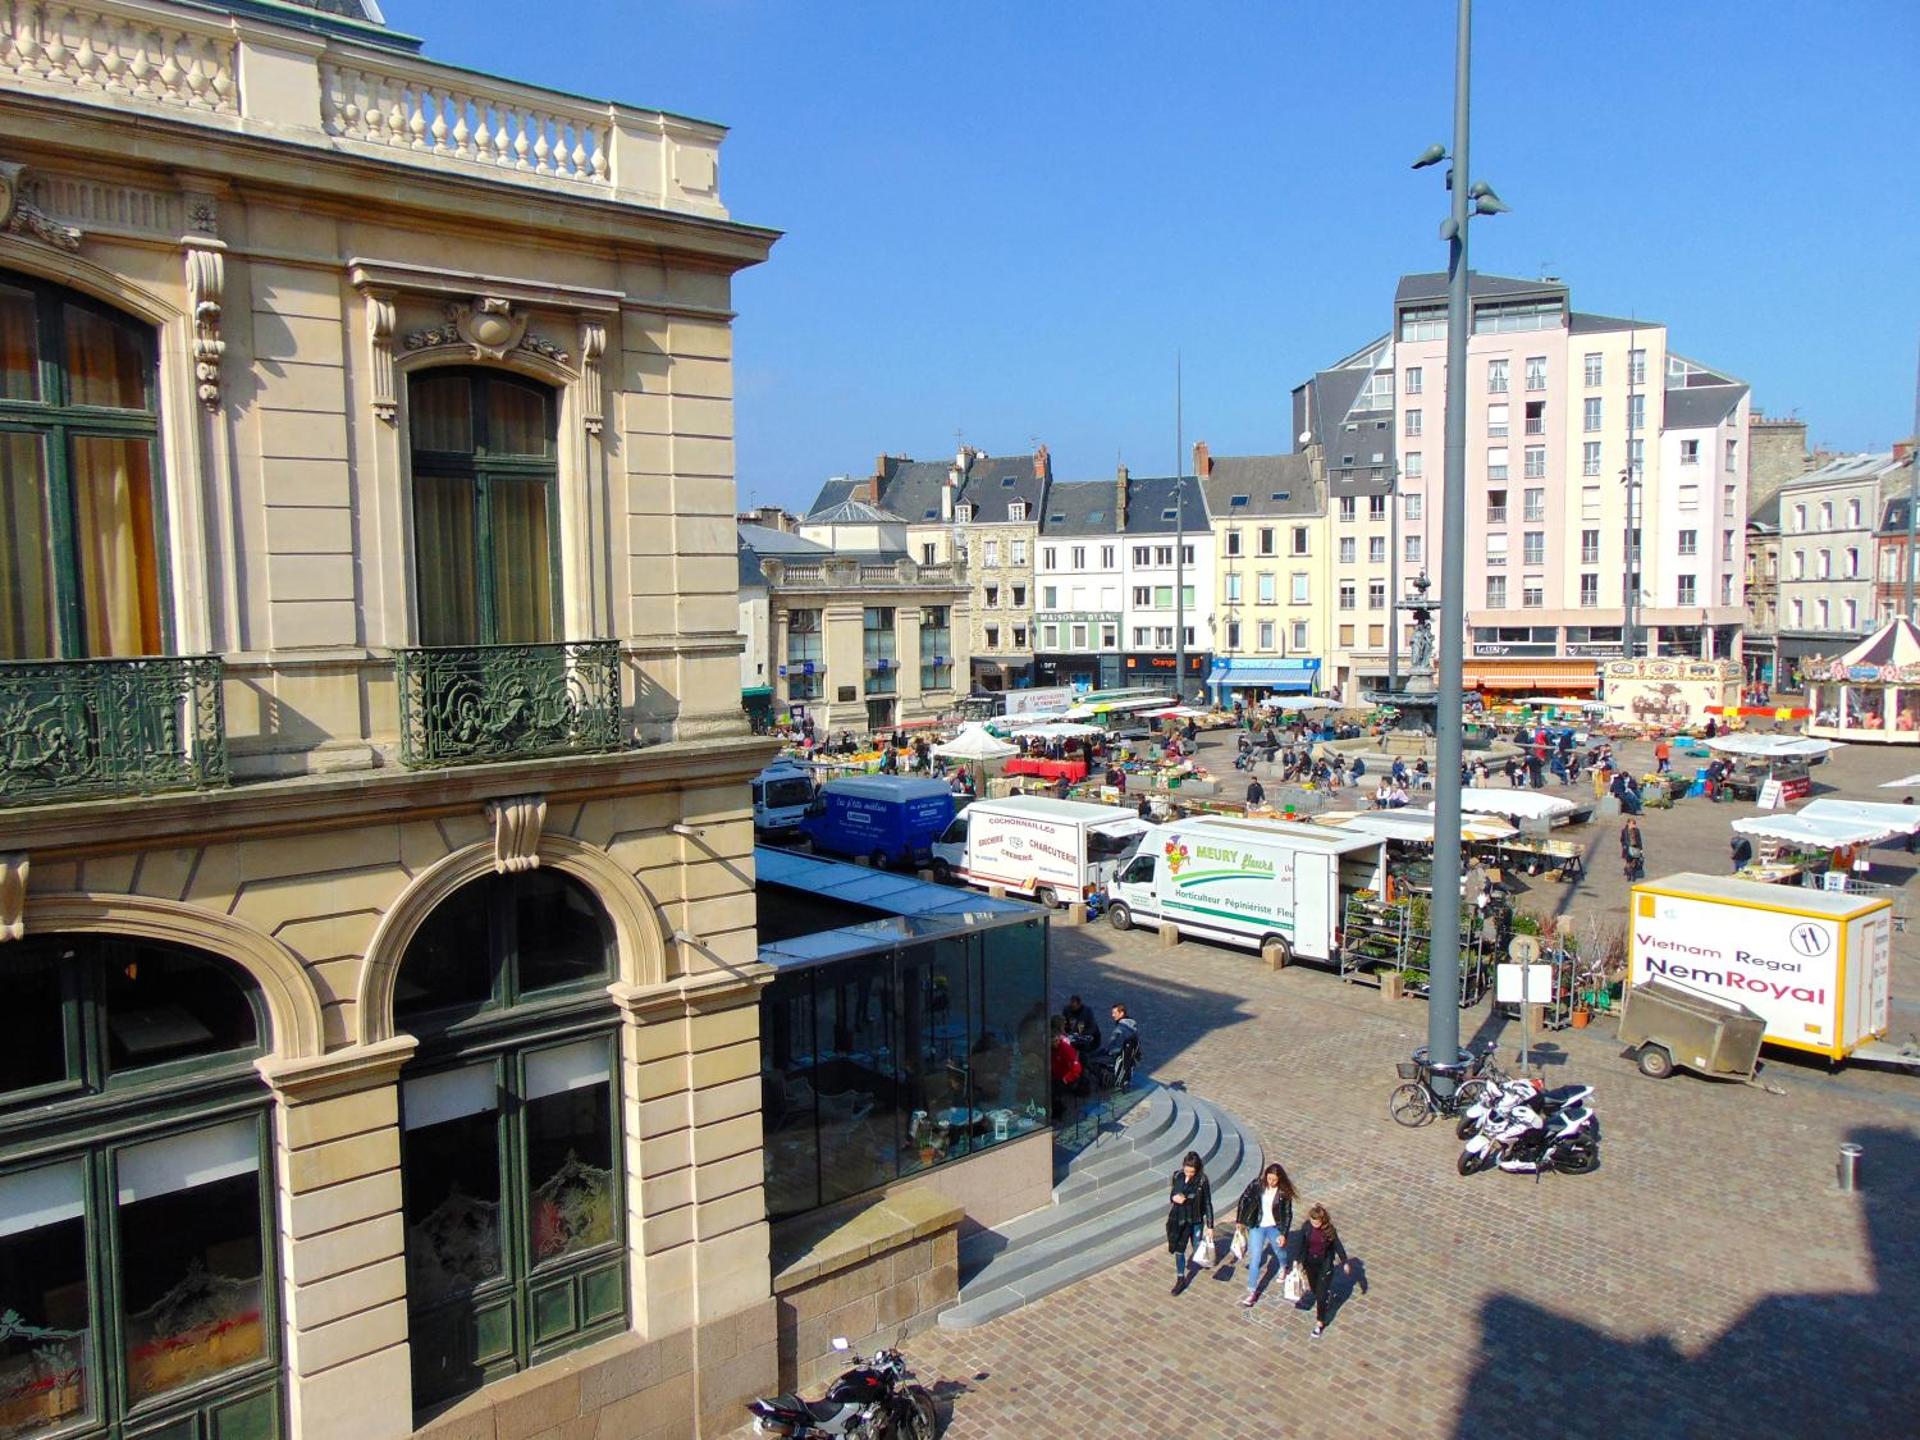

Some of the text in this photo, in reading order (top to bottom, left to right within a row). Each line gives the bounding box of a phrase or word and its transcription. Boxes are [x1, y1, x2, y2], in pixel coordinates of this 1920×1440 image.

[1040, 613, 1075, 622] MAISON
[1151, 658, 1176, 668] Orange
[989, 818, 1055, 833] COCHONNAILLES
[1029, 839, 1077, 864] CHARCUTERIE
[1196, 845, 1238, 863] MEURY
[1175, 889, 1220, 905] Horticulteur
[1225, 898, 1272, 914] Pépiniériste
[1636, 933, 1802, 973] Vietnam Regal
[1645, 957, 1825, 1005] NemRoyal
